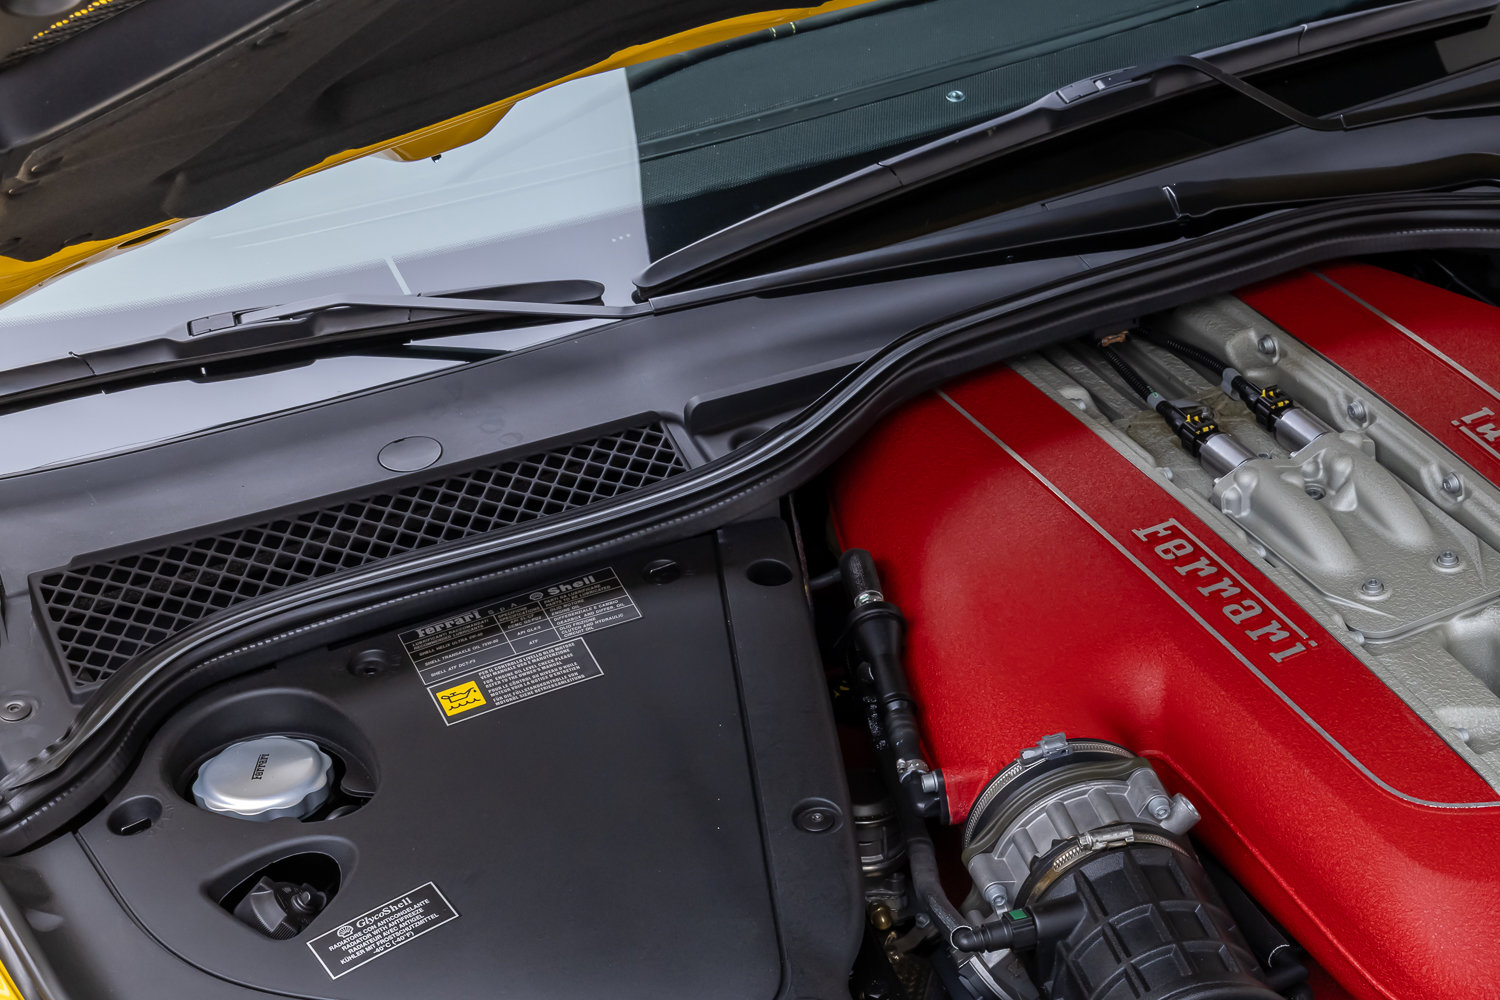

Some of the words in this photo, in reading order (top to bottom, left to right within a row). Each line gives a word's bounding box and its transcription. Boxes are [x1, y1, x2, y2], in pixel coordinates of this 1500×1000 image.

[546, 574, 595, 595] Shell
[1134, 518, 1319, 664] Ferrari
[415, 610, 481, 637] Ferrari
[423, 658, 441, 666] SHELL
[430, 669, 446, 677] SHELL
[328, 931, 363, 951] RADIATORE
[362, 924, 377, 934] CON
[376, 898, 429, 927] ANTICONGELANTE
[341, 933, 372, 951] RADIATOR
[371, 925, 388, 935] WITH
[387, 907, 423, 927] ANTIFREEZE
[354, 896, 412, 929] GlycoShell
[339, 948, 365, 964] KÜHLER
[364, 943, 376, 951] MIT
[375, 911, 439, 946] FROSTSCHUTZMITTEL
[347, 934, 382, 954] RADIATEUR
[381, 926, 398, 936] AVEC
[397, 913, 424, 928] ANTIGEL
